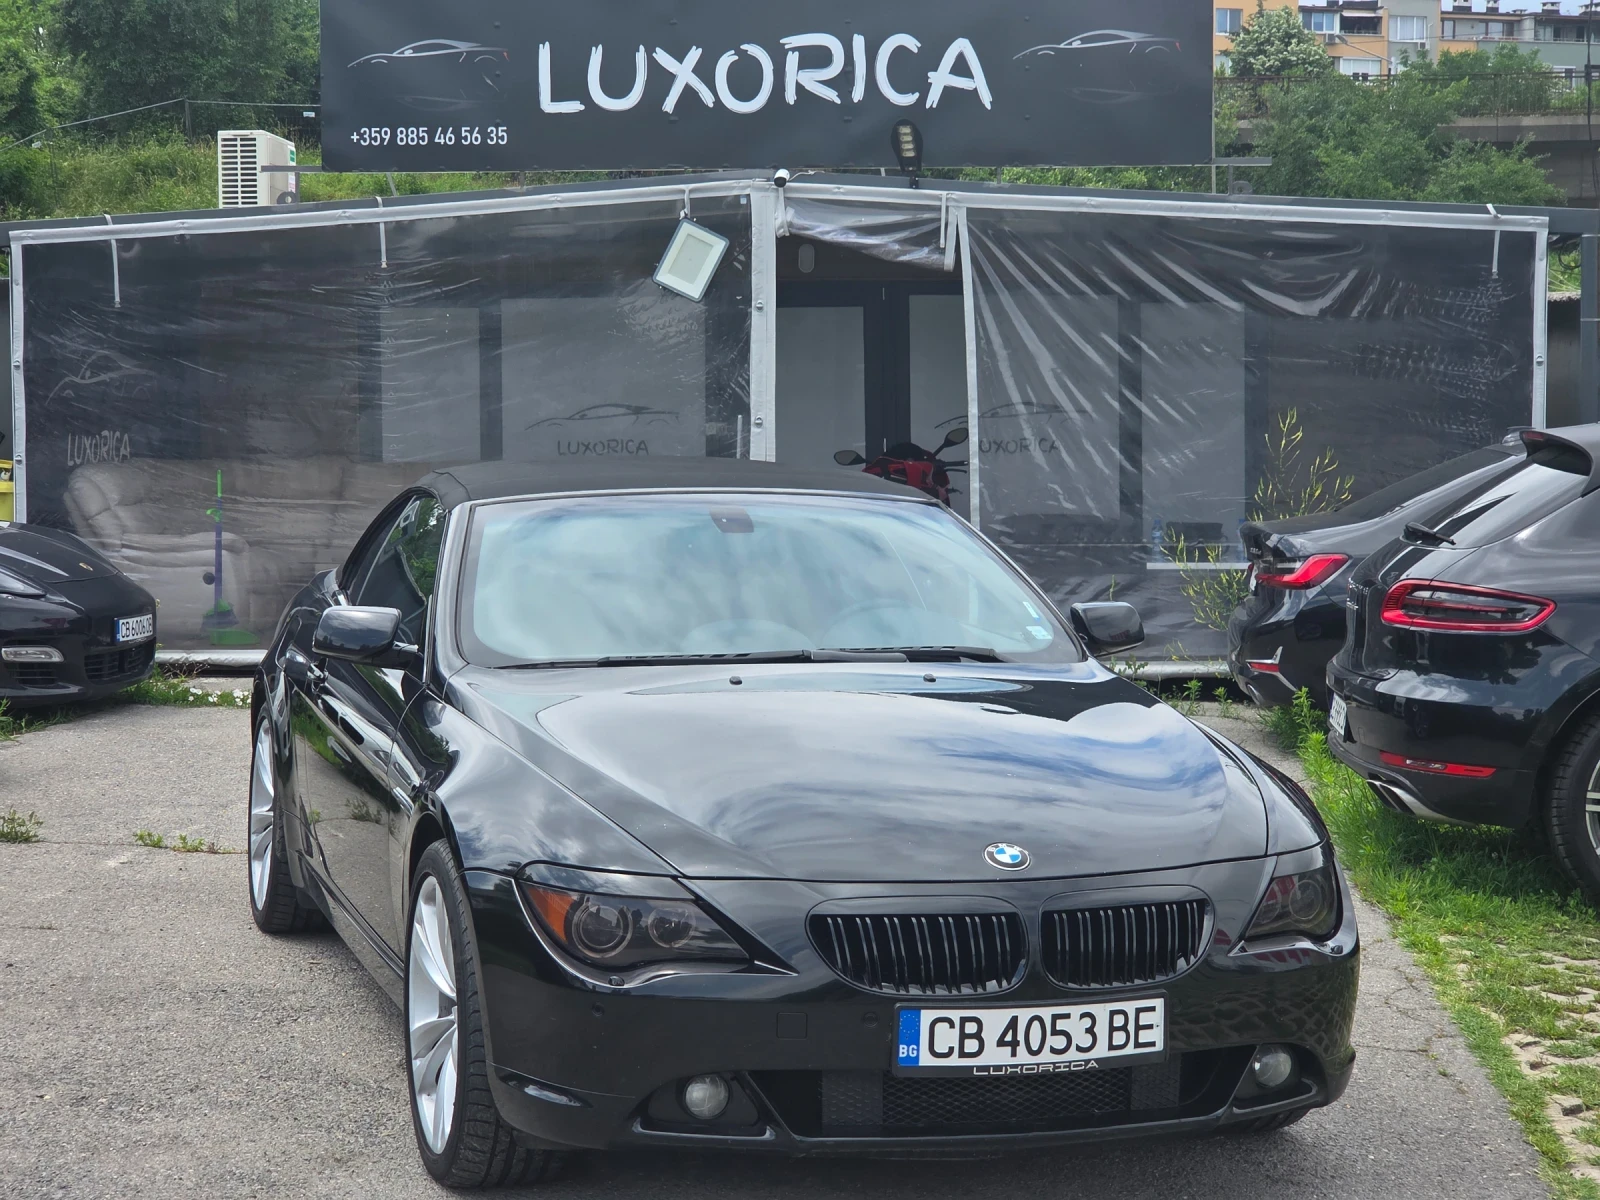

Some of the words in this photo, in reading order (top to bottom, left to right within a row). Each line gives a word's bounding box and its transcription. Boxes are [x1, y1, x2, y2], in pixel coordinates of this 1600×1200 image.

[537, 33, 993, 114] LUXORICA
[350, 127, 391, 146] +359
[396, 127, 429, 146] 885
[434, 126, 456, 146] 46
[461, 126, 482, 145] 56
[486, 126, 508, 145] 35
[67, 430, 130, 466] LUXORICA
[557, 439, 649, 457] LUXORICA
[978, 437, 1059, 454] UXORICA
[928, 1016, 985, 1059] CB
[996, 1011, 1098, 1058] 4053
[1107, 1005, 1157, 1051] BE
[899, 1045, 918, 1058] BG
[973, 1059, 1099, 1076] LUXORICA
